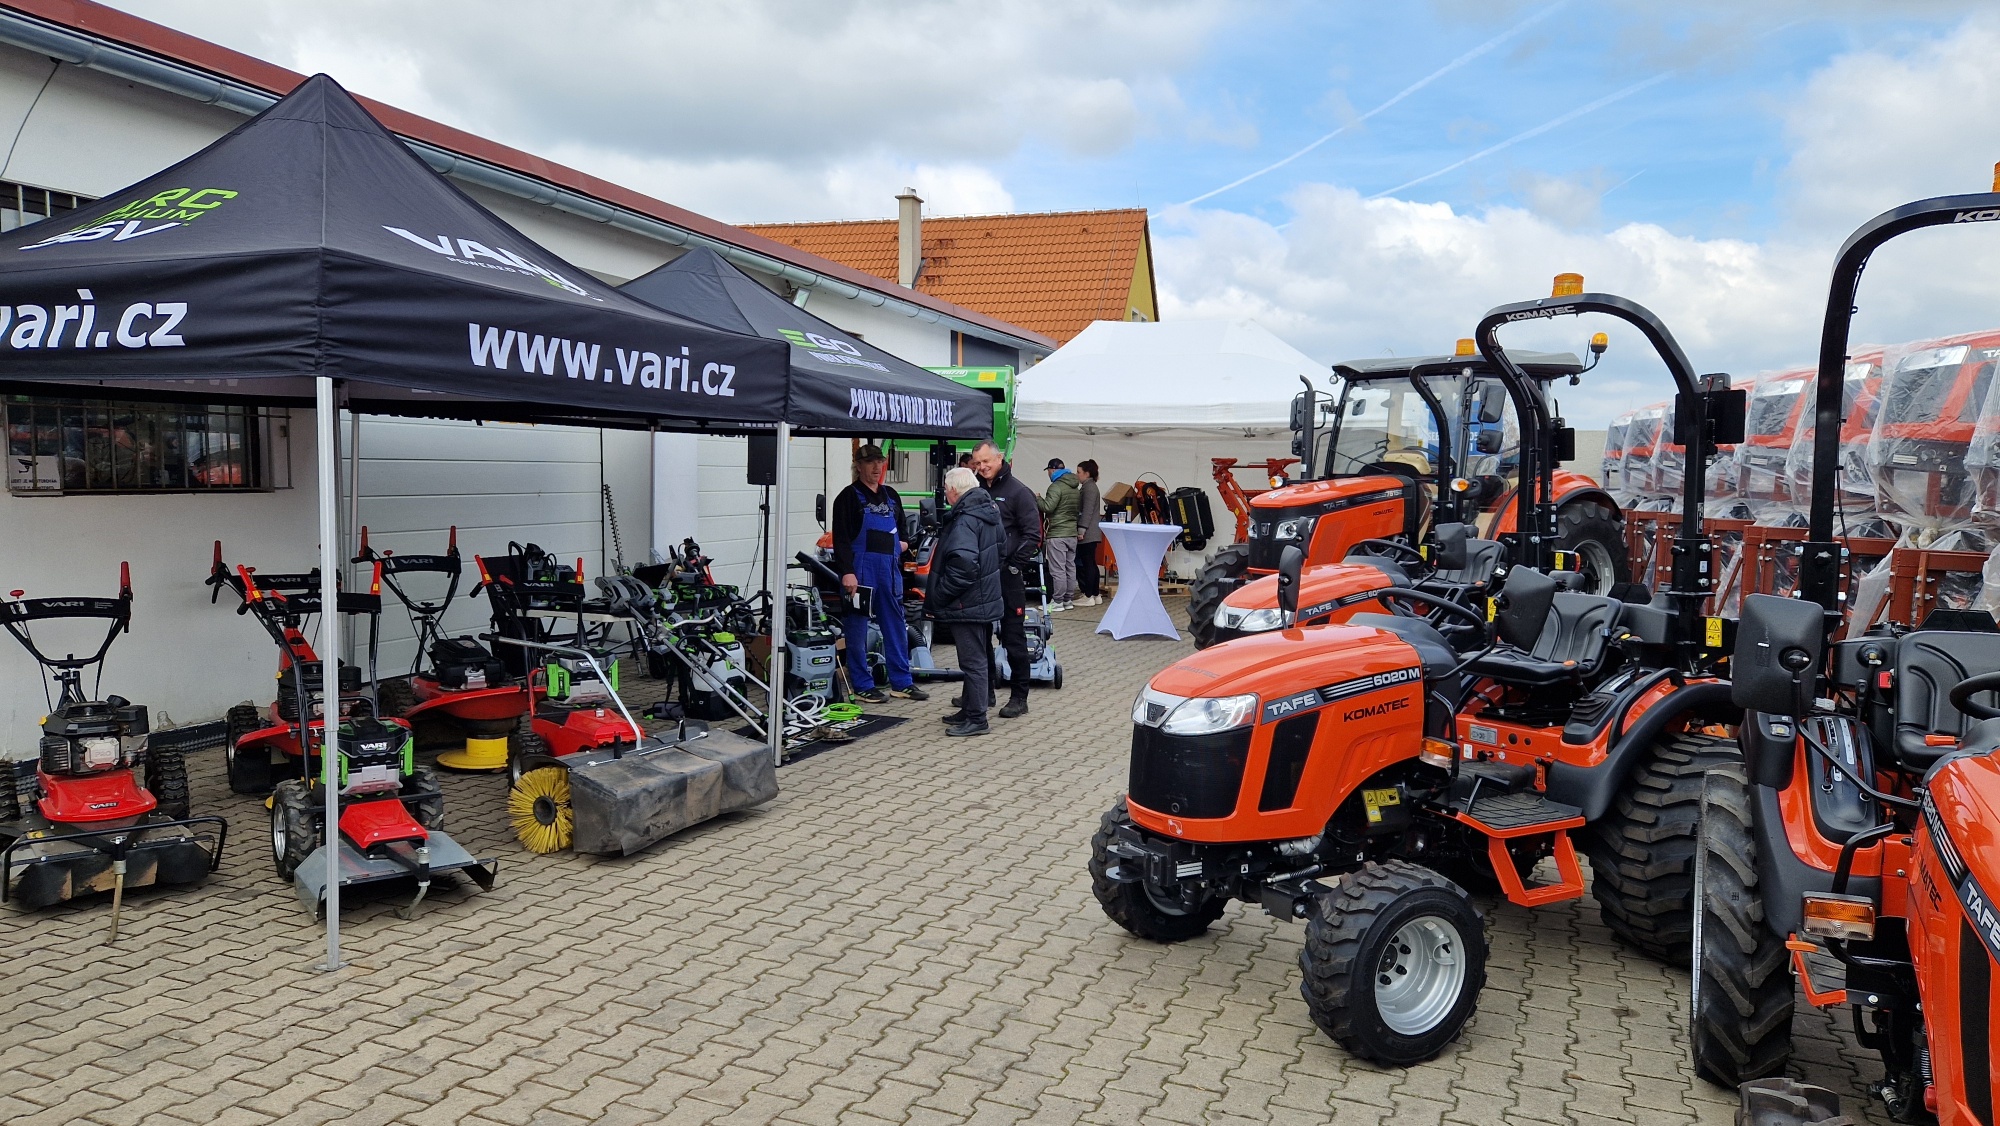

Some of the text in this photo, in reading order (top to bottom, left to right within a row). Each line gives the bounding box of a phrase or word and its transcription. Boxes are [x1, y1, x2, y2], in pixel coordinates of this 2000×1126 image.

[1954, 210, 2000, 222] KO
[1506, 305, 1577, 321] KOMATEC
[777, 328, 862, 357] EGO
[468, 322, 736, 397] www.vari.cz
[849, 387, 953, 427] POWER BEYOND BELIEF
[1323, 499, 1348, 510] TAFE
[1305, 602, 1333, 616] TAFE
[1373, 669, 1408, 686] 6020
[1267, 693, 1317, 717] TAFE
[1343, 697, 1410, 722] KOMATEC
[360, 741, 388, 750] VARI
[1918, 862, 1943, 912] MATEC
[1966, 881, 2000, 951] TAFE
